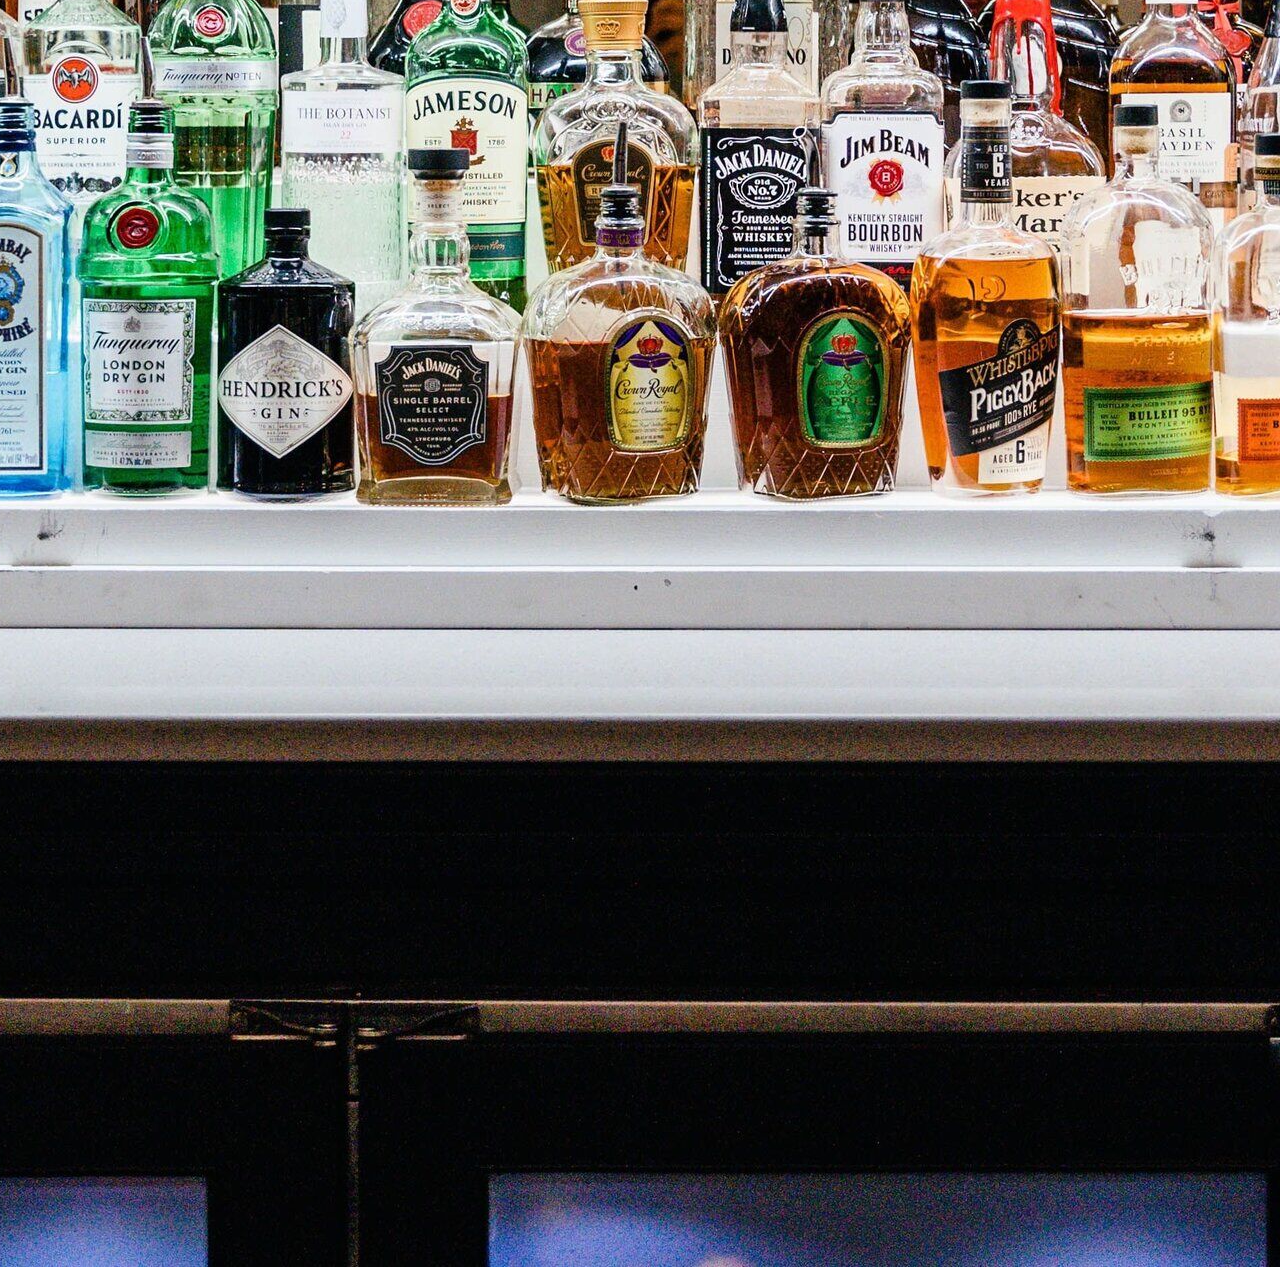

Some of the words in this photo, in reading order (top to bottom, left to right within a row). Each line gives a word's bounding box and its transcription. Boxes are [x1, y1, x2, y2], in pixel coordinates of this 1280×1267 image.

[241, 72, 262, 80] TEN
[413, 90, 517, 121] JAMESON
[297, 107, 321, 120] THE
[326, 107, 393, 120] BOTANIST
[46, 136, 107, 145] SUPERIOR
[487, 138, 506, 146] 1780
[840, 132, 878, 169] JIM
[879, 129, 931, 169] BEAM
[987, 143, 1009, 154] AGED
[1160, 141, 1214, 152] AYDEN
[715, 150, 750, 180] JACK
[991, 152, 1007, 179] 6
[465, 171, 504, 181] ISTILLED
[753, 178, 771, 187] Old
[983, 178, 1010, 188] YEARS
[847, 214, 886, 223] KENTUCKY
[888, 213, 924, 222] STRAIGHT
[732, 232, 793, 243] WHISKEY
[847, 223, 924, 243] BOURBON
[869, 244, 903, 253] WHISKEY
[92, 329, 181, 355] Tanqueray
[6, 366, 27, 374] GIN
[103, 359, 166, 370] LONDON
[401, 361, 426, 380] JACK
[425, 357, 463, 382] DANIEL'S
[103, 372, 132, 384] DRY
[136, 372, 166, 384] GIN
[222, 379, 344, 399] HENDRICK'S
[615, 378, 648, 399] Crown
[640, 377, 682, 399] Royal
[393, 396, 429, 406] SINGLE
[432, 396, 473, 406] BARREL
[260, 407, 301, 420] GIN
[415, 406, 450, 414] SELECT
[1023, 400, 1038, 417] RYE
[1128, 407, 1178, 421] BULLEIT
[1181, 407, 1196, 418] 95
[992, 453, 1014, 464] AGED
[1015, 439, 1026, 464] 6
